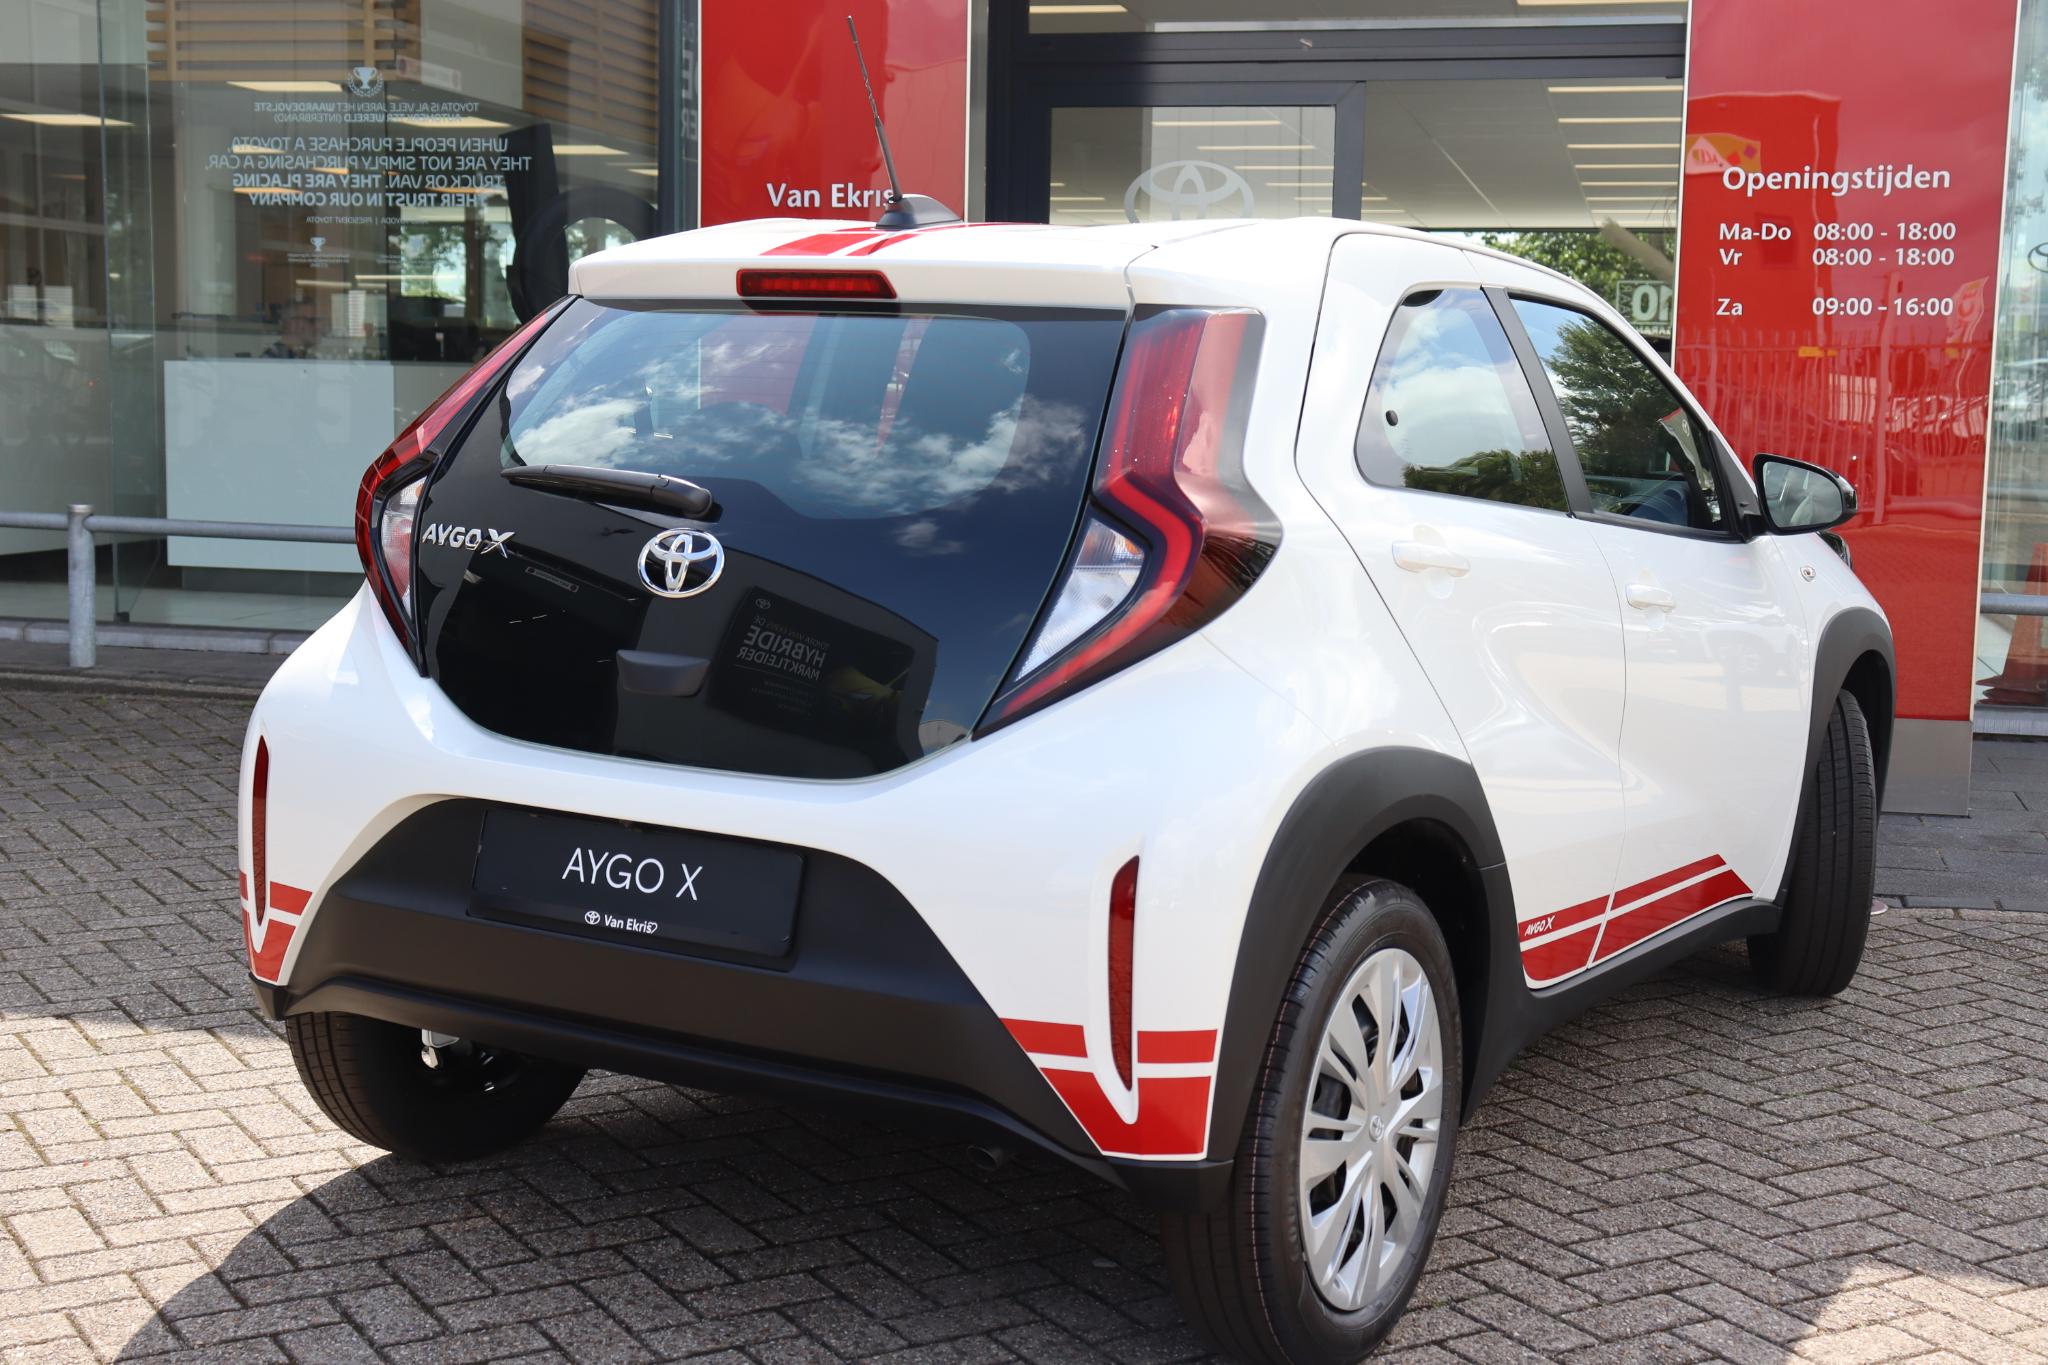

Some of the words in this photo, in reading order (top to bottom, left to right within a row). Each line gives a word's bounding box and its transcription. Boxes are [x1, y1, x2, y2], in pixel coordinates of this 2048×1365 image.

[1722, 165, 1951, 197] Openingstijden
[766, 183, 820, 208] Van
[1718, 223, 1792, 241] Ma-Do
[1813, 223, 1873, 240] 08:00
[1896, 223, 1956, 240] 18:00
[1719, 248, 1743, 266] Vr
[1812, 248, 1872, 266] 08:00
[1895, 248, 1955, 266] 18:00
[1716, 298, 1743, 316] Za
[1812, 298, 1872, 315] 09:00
[1893, 297, 1954, 315] 16:00
[422, 523, 482, 550] AYGO
[561, 847, 665, 894] AYGO
[675, 863, 704, 901] X
[604, 914, 624, 929] Van
